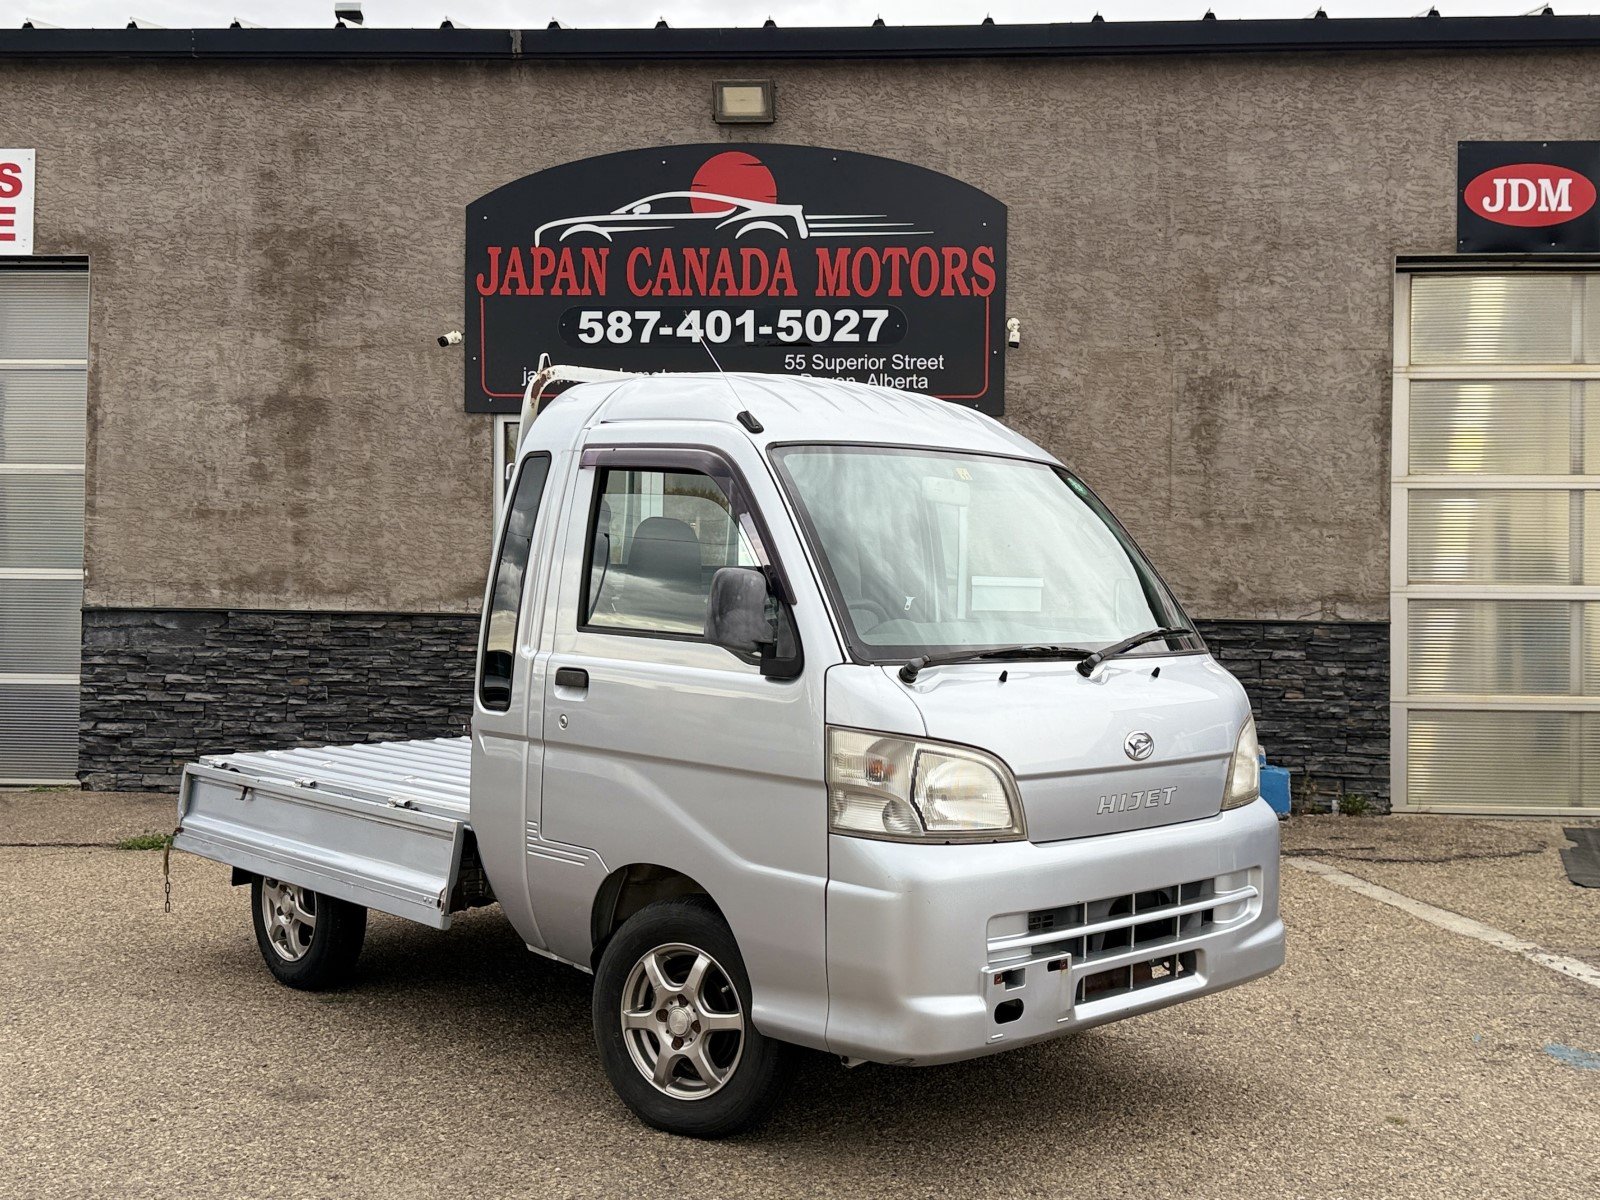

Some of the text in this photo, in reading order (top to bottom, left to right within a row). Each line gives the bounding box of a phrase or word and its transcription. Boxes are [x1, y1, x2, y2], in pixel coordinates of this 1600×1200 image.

[1482, 178, 1573, 213] JDM
[476, 246, 996, 298] JAPAN CANADA MOTORS
[577, 309, 889, 344] 587-401-5027
[784, 353, 945, 374] 55 Superior Street
[867, 373, 929, 389] Alberta
[1096, 785, 1178, 815] HIJET
